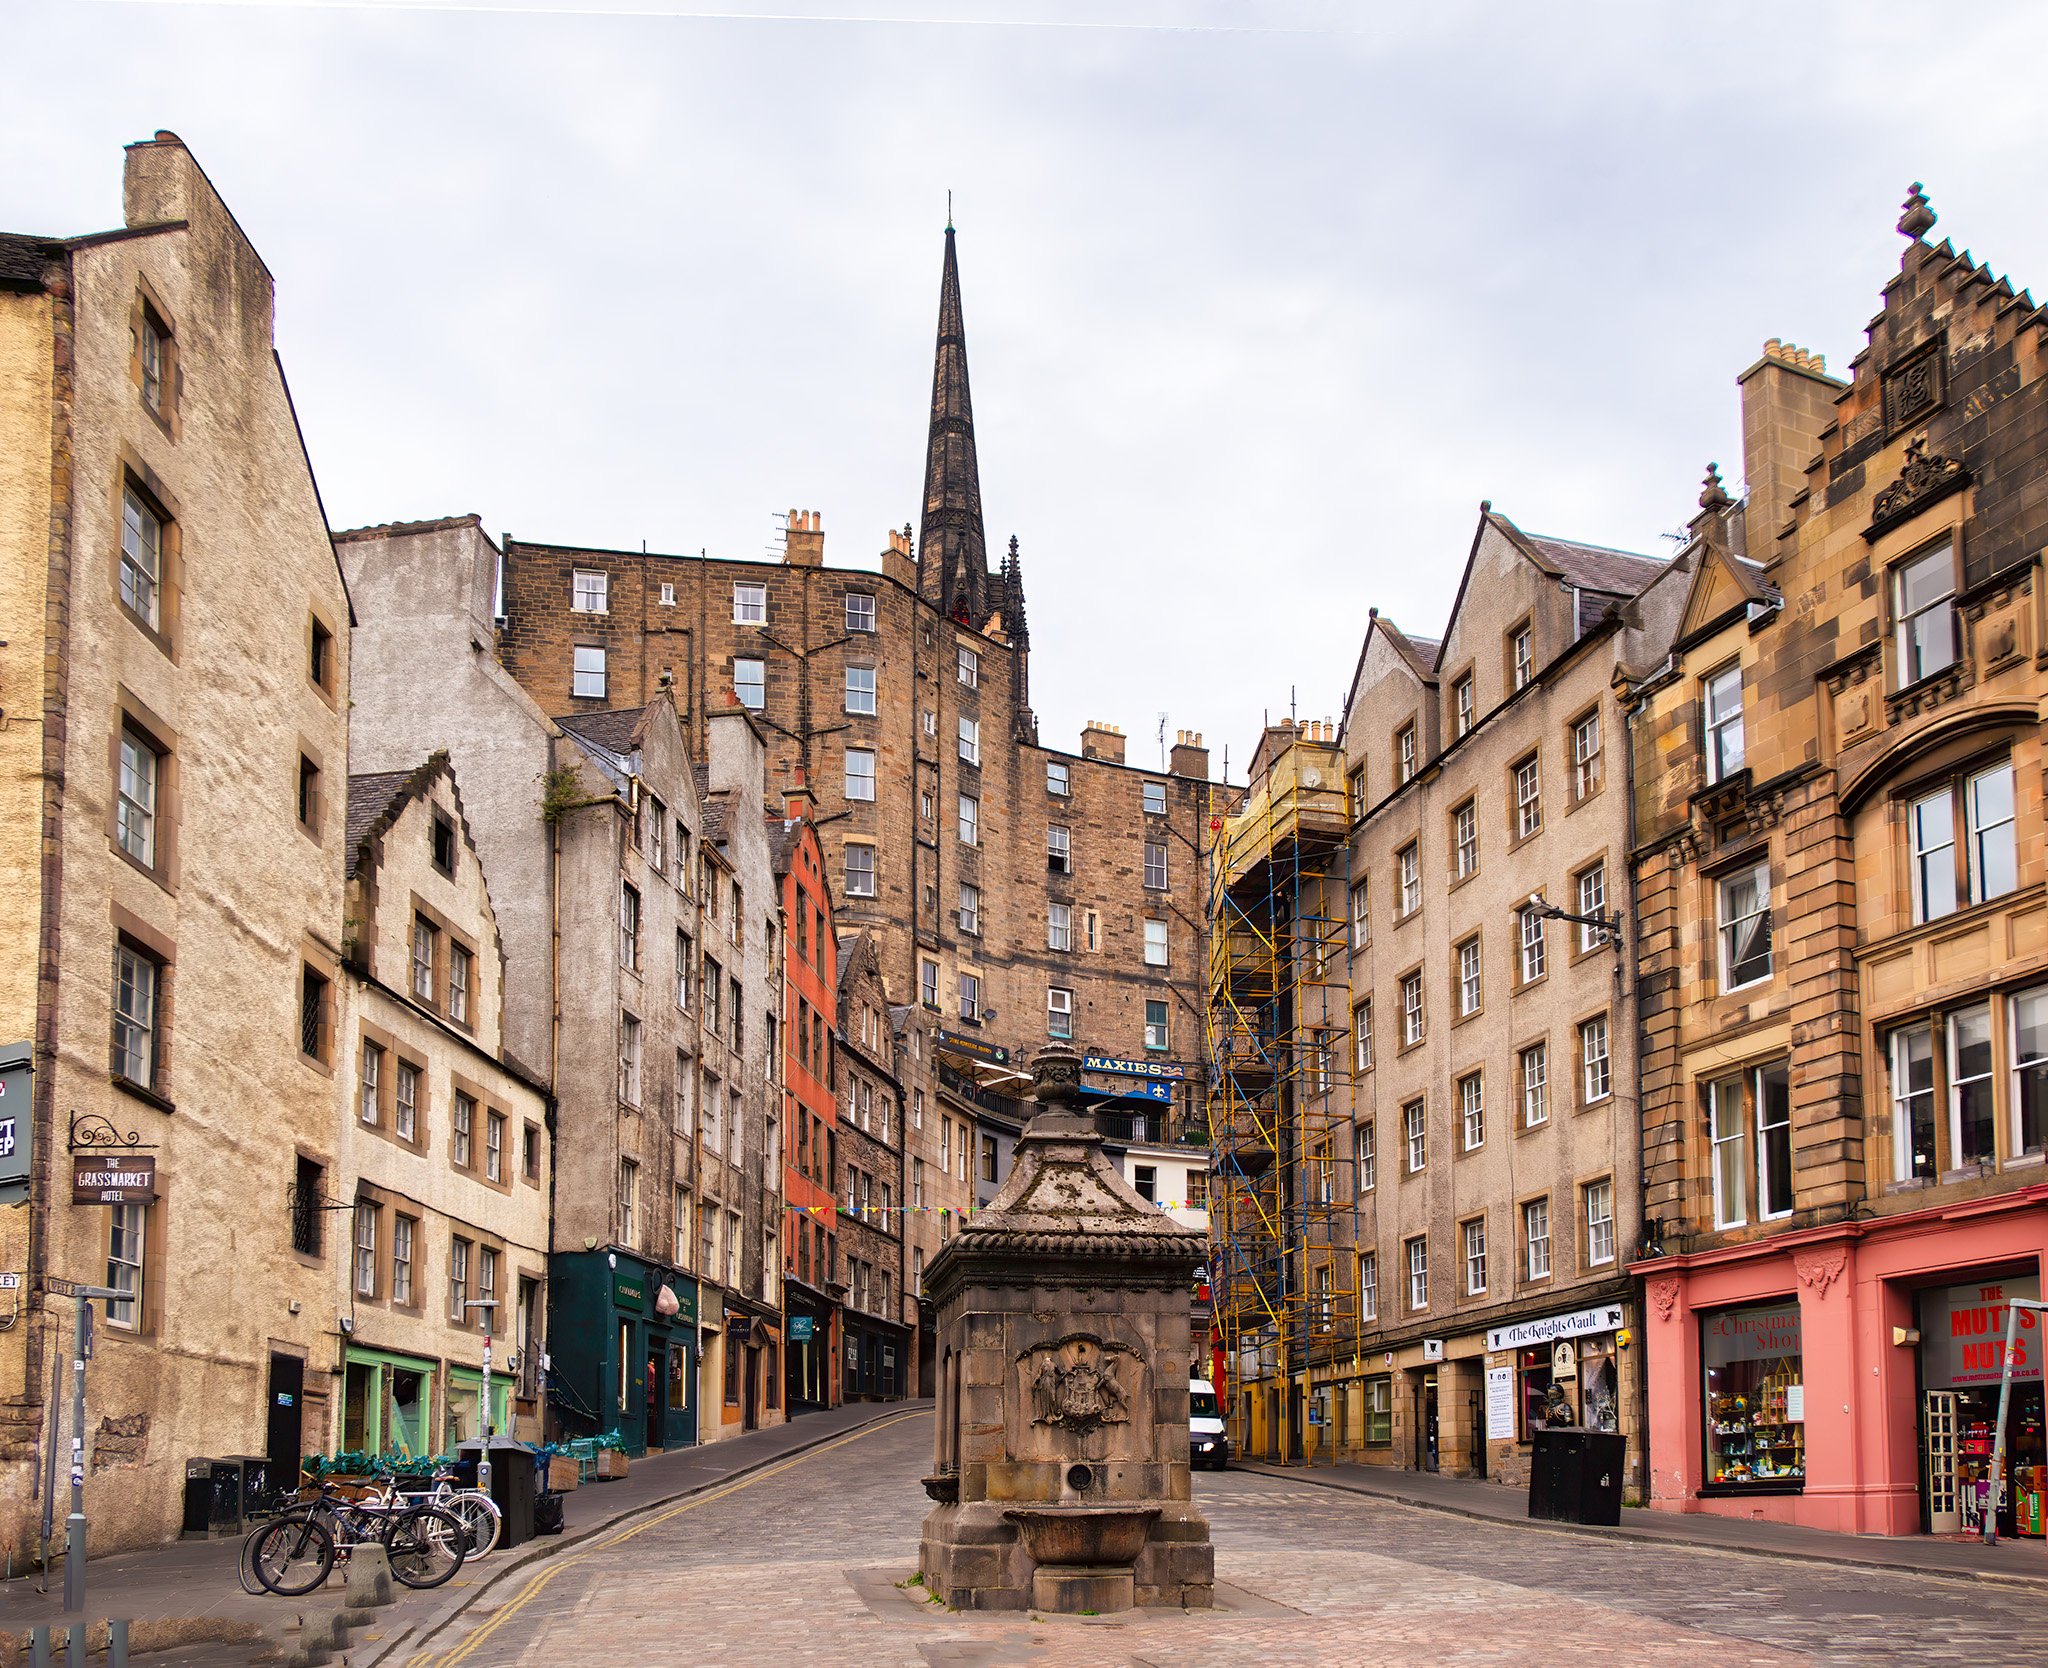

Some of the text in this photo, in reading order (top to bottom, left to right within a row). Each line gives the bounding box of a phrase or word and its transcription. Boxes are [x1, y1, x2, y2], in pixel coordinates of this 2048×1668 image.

[1086, 1057, 1162, 1075] MAXIES
[105, 1158, 120, 1168] THE
[78, 1172, 150, 1187] GRASSMARKET
[101, 1191, 124, 1201] HOTEL
[51, 1280, 68, 1294] WEST
[1979, 1286, 2003, 1301] THE
[1509, 1312, 1597, 1341] The Knights Vault
